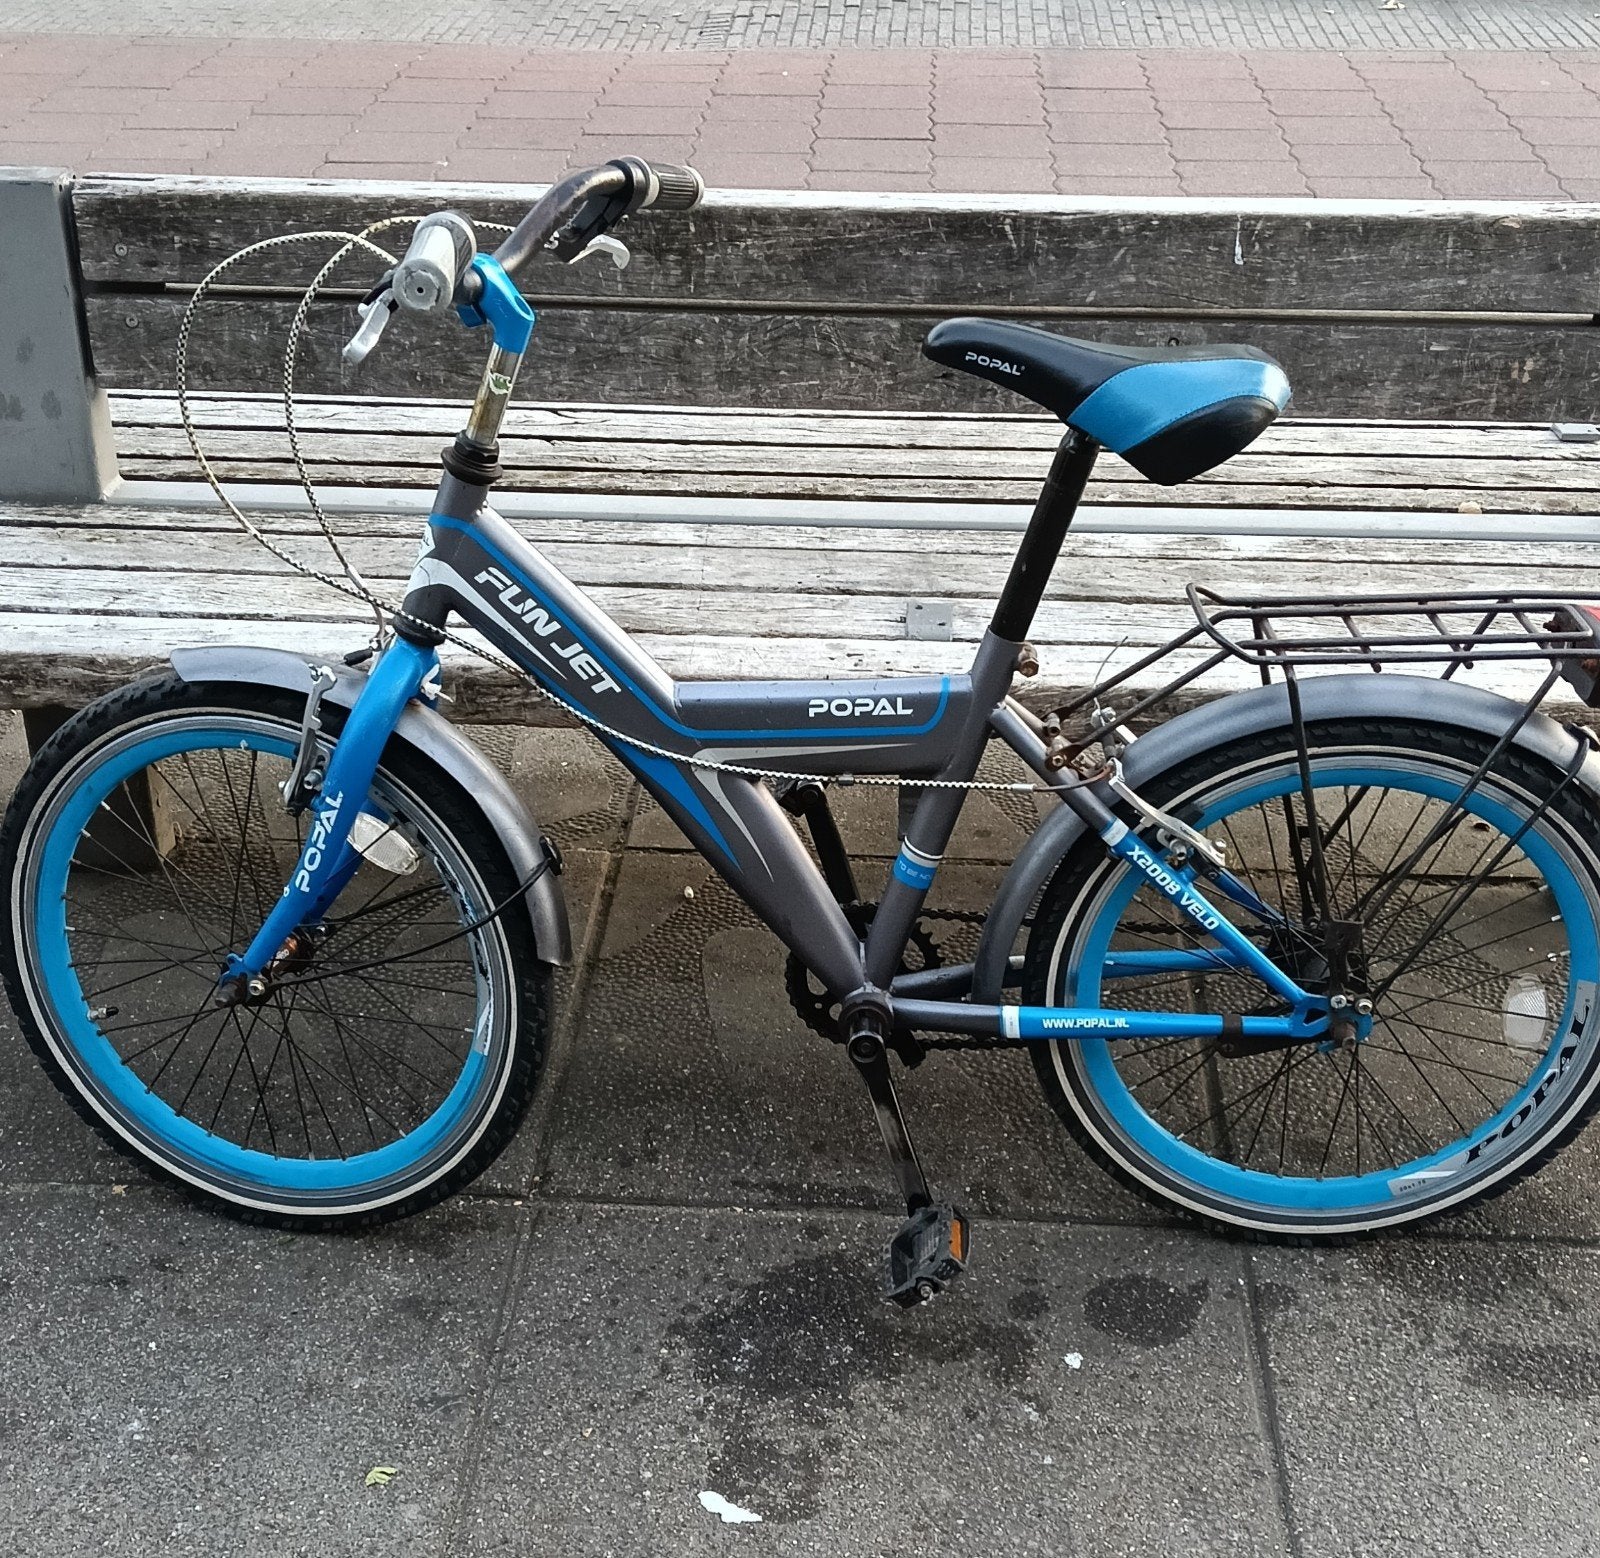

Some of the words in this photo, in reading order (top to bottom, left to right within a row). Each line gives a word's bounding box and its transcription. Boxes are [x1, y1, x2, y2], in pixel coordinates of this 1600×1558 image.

[965, 351, 1021, 376] POPAL
[474, 566, 561, 637] FUN
[550, 642, 622, 694] JET
[808, 697, 914, 718] POPAL
[295, 790, 343, 893] POPAL
[1127, 844, 1182, 895] X2008
[1180, 892, 1220, 930] VELO
[1042, 1018, 1130, 1029] WWW.POPAL.NL
[1465, 1005, 1590, 1166] POPAL
